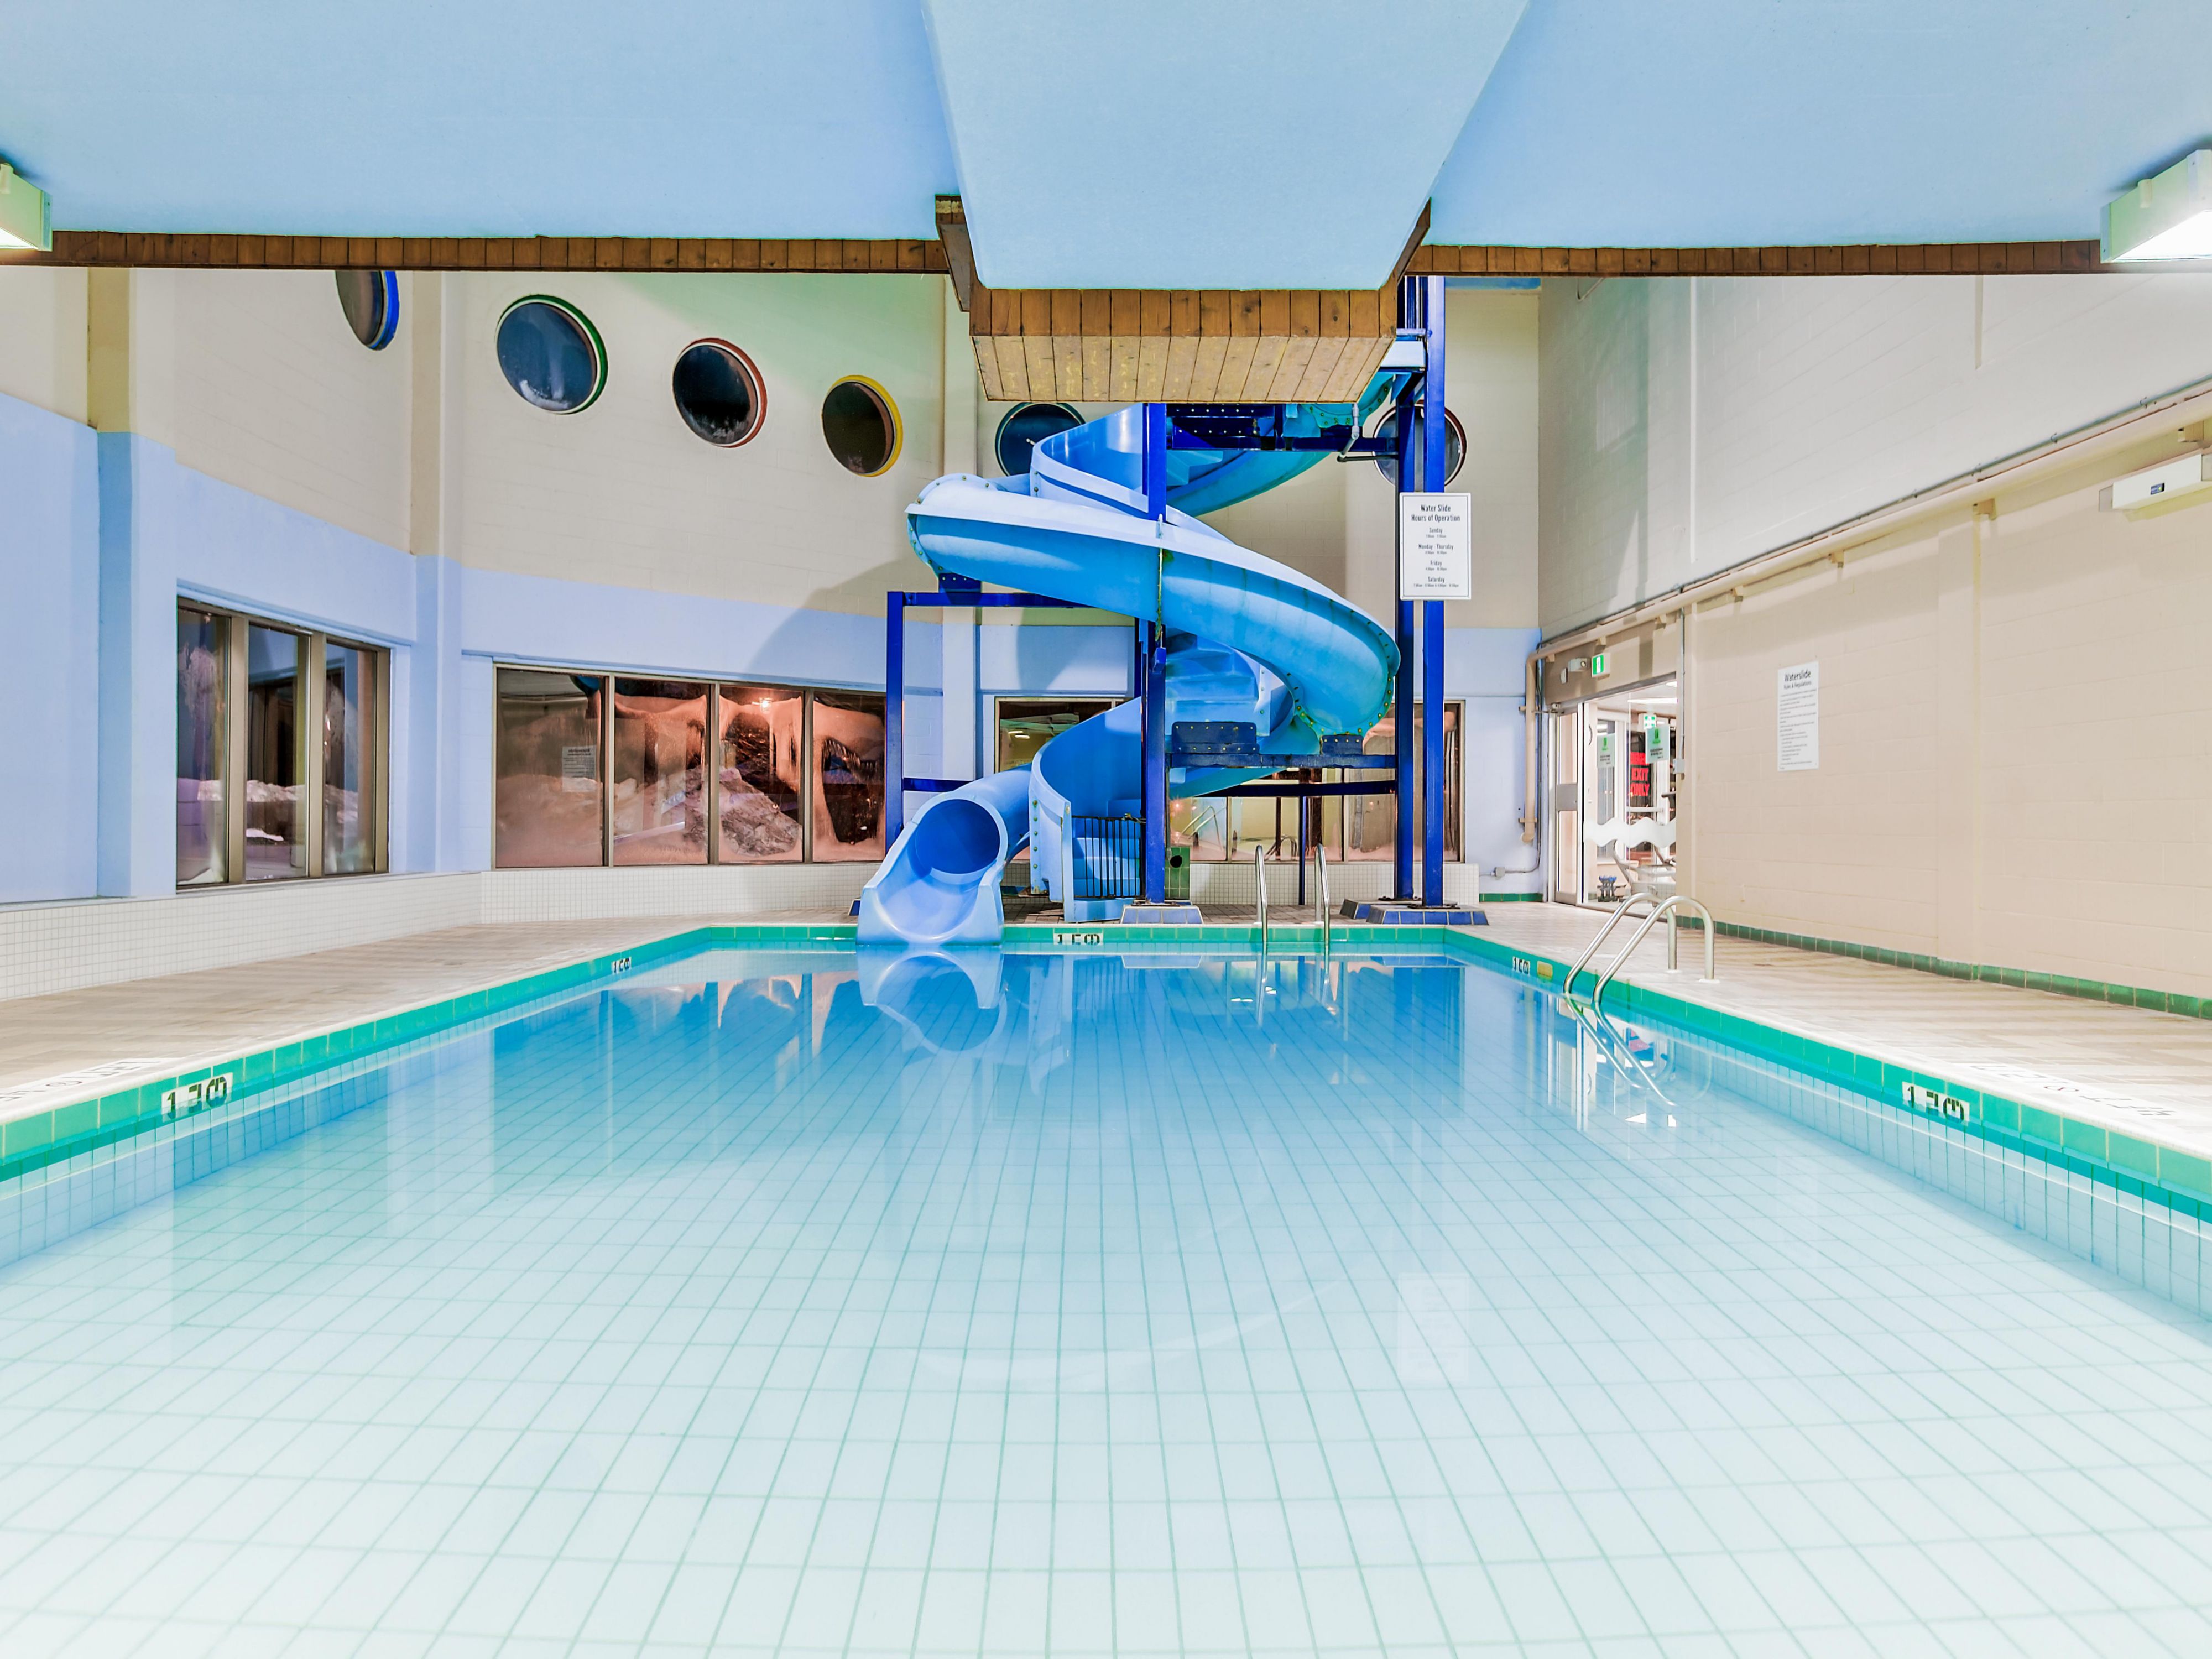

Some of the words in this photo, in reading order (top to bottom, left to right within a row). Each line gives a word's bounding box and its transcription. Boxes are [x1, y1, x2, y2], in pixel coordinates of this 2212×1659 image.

[1435, 514, 1460, 523] Operation
[1784, 668, 1811, 682] Waterslide
[1632, 768, 1648, 781] EXIT
[1631, 783, 1650, 796] ONLY
